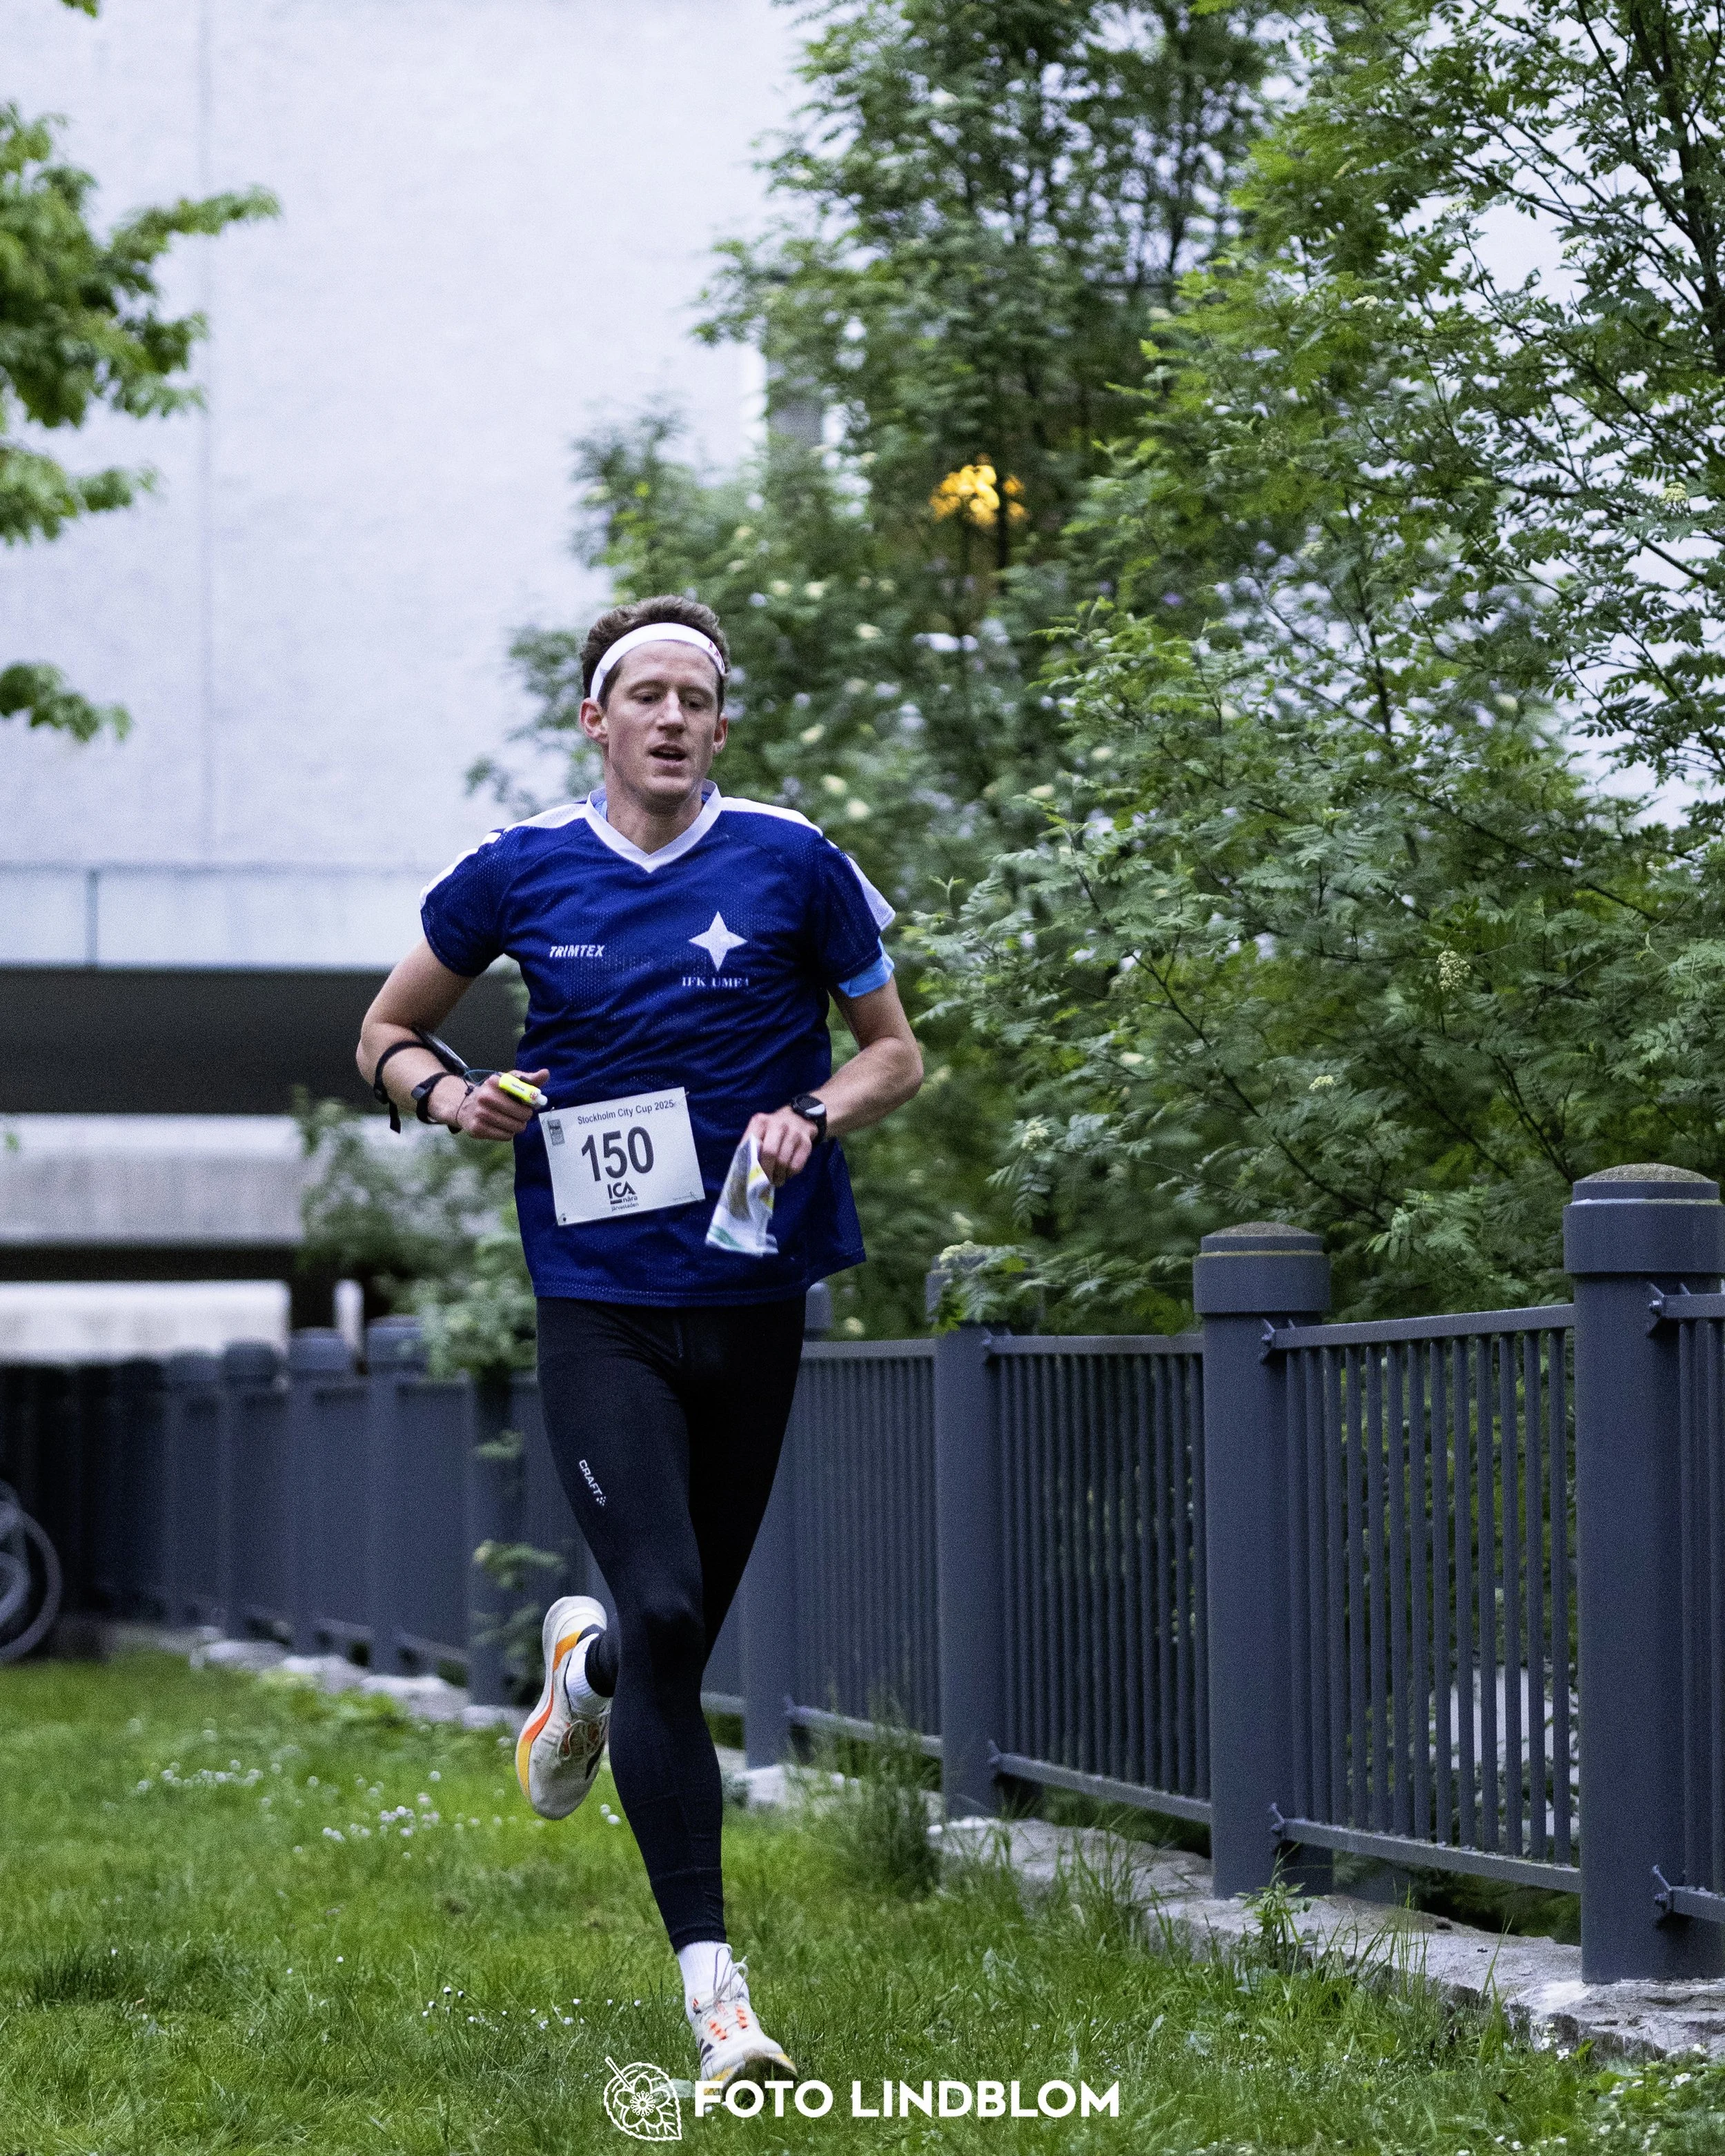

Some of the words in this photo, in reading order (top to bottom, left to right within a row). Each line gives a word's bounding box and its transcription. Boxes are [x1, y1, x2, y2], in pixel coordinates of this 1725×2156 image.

[549, 945, 605, 958] TRIMTEX
[682, 976, 706, 987] IFK
[578, 1111, 616, 1125] Stockholm
[618, 1107, 633, 1117] City
[635, 1105, 653, 1114] Cup
[655, 1099, 675, 1111] 2025
[581, 1126, 654, 1182] 150
[607, 1180, 636, 1199] ICA
[579, 1459, 602, 1495] CRAFT
